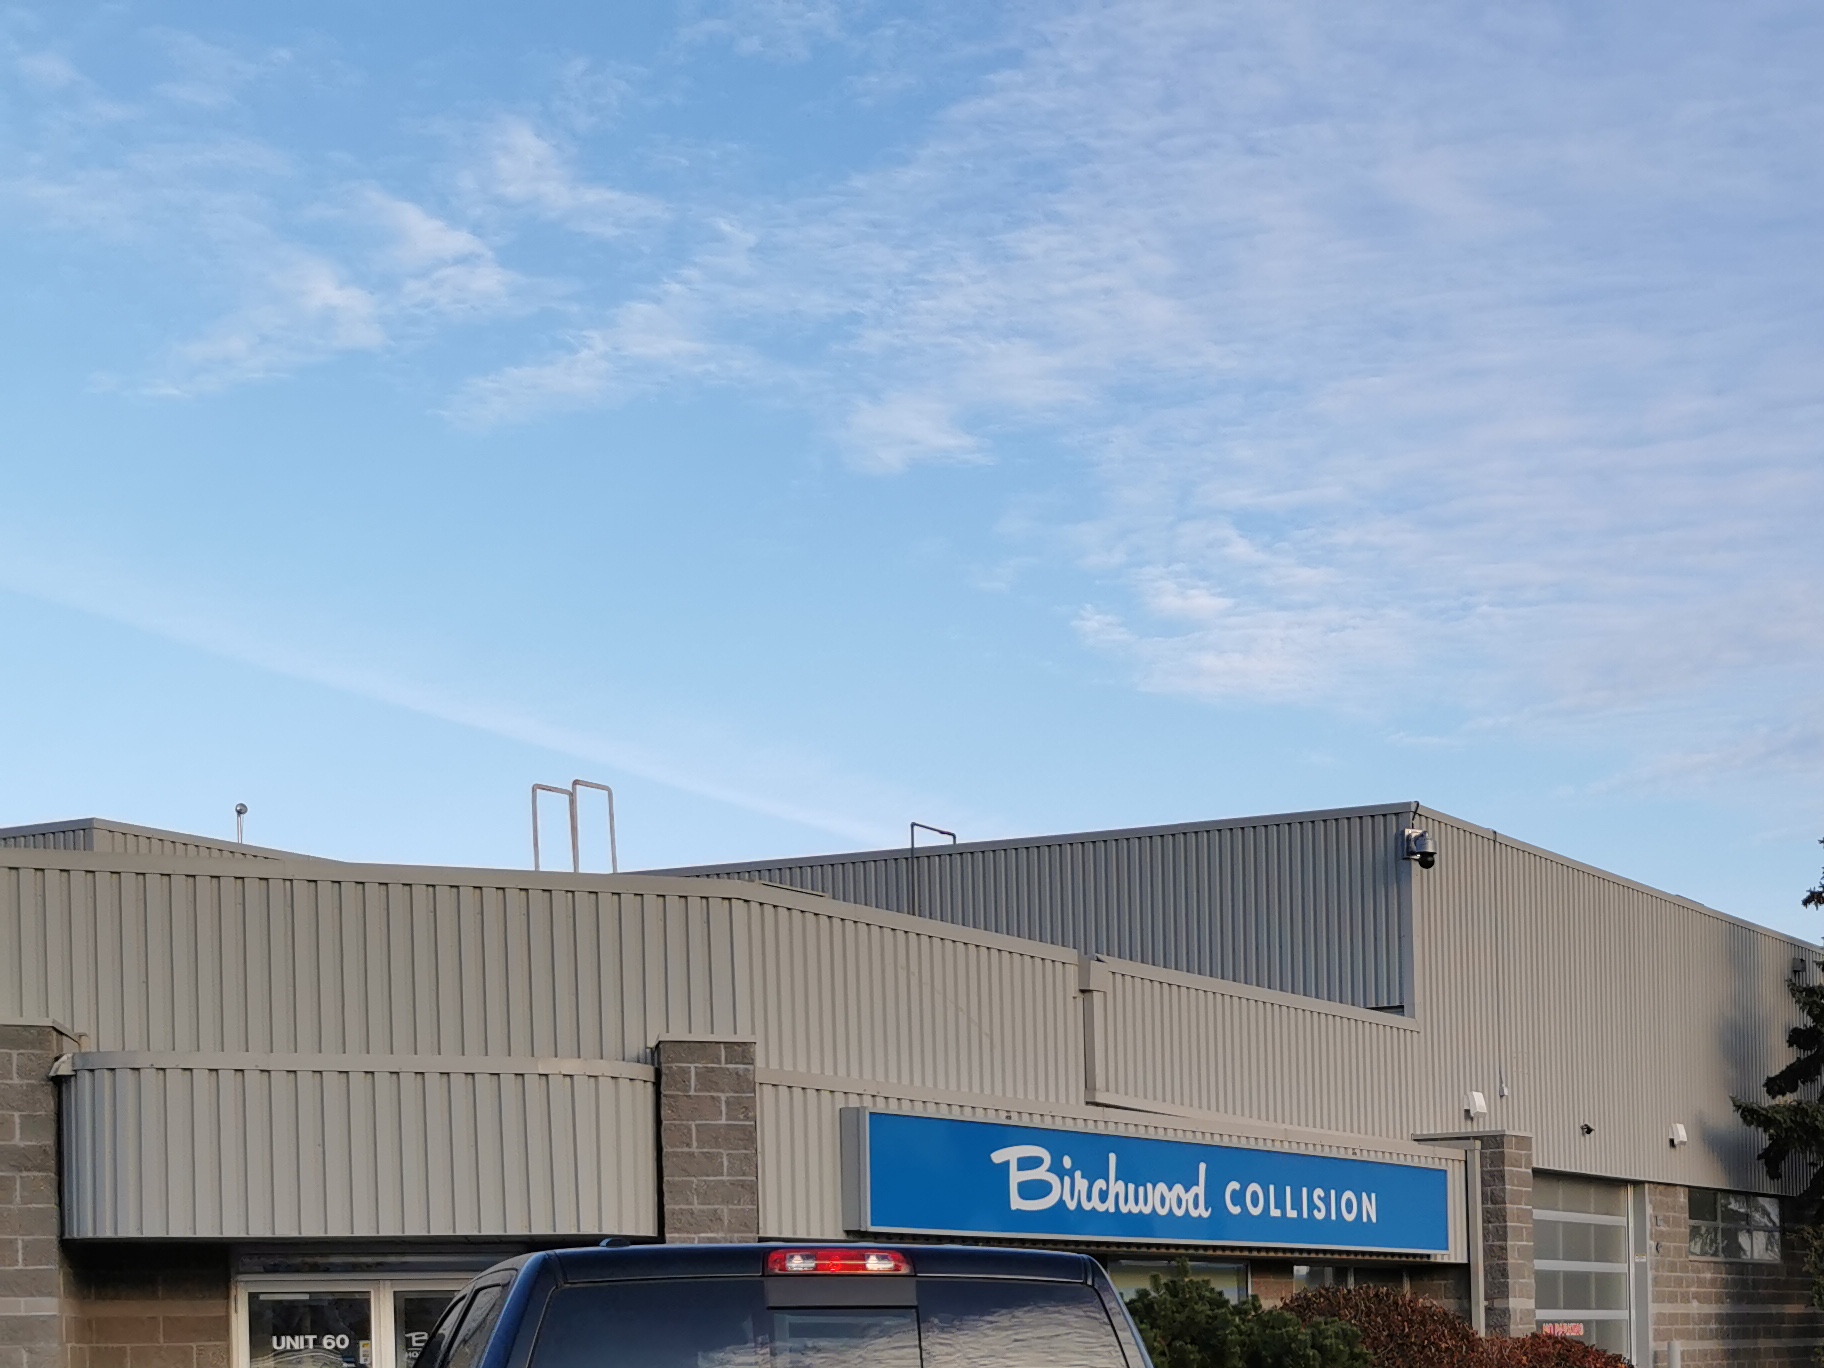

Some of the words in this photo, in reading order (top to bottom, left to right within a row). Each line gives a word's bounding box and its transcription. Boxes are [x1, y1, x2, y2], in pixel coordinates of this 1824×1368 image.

[990, 1144, 1212, 1218] Birchwood
[1225, 1180, 1377, 1223] COLLISION
[272, 1335, 317, 1350] UNIT
[322, 1334, 349, 1350] 60
